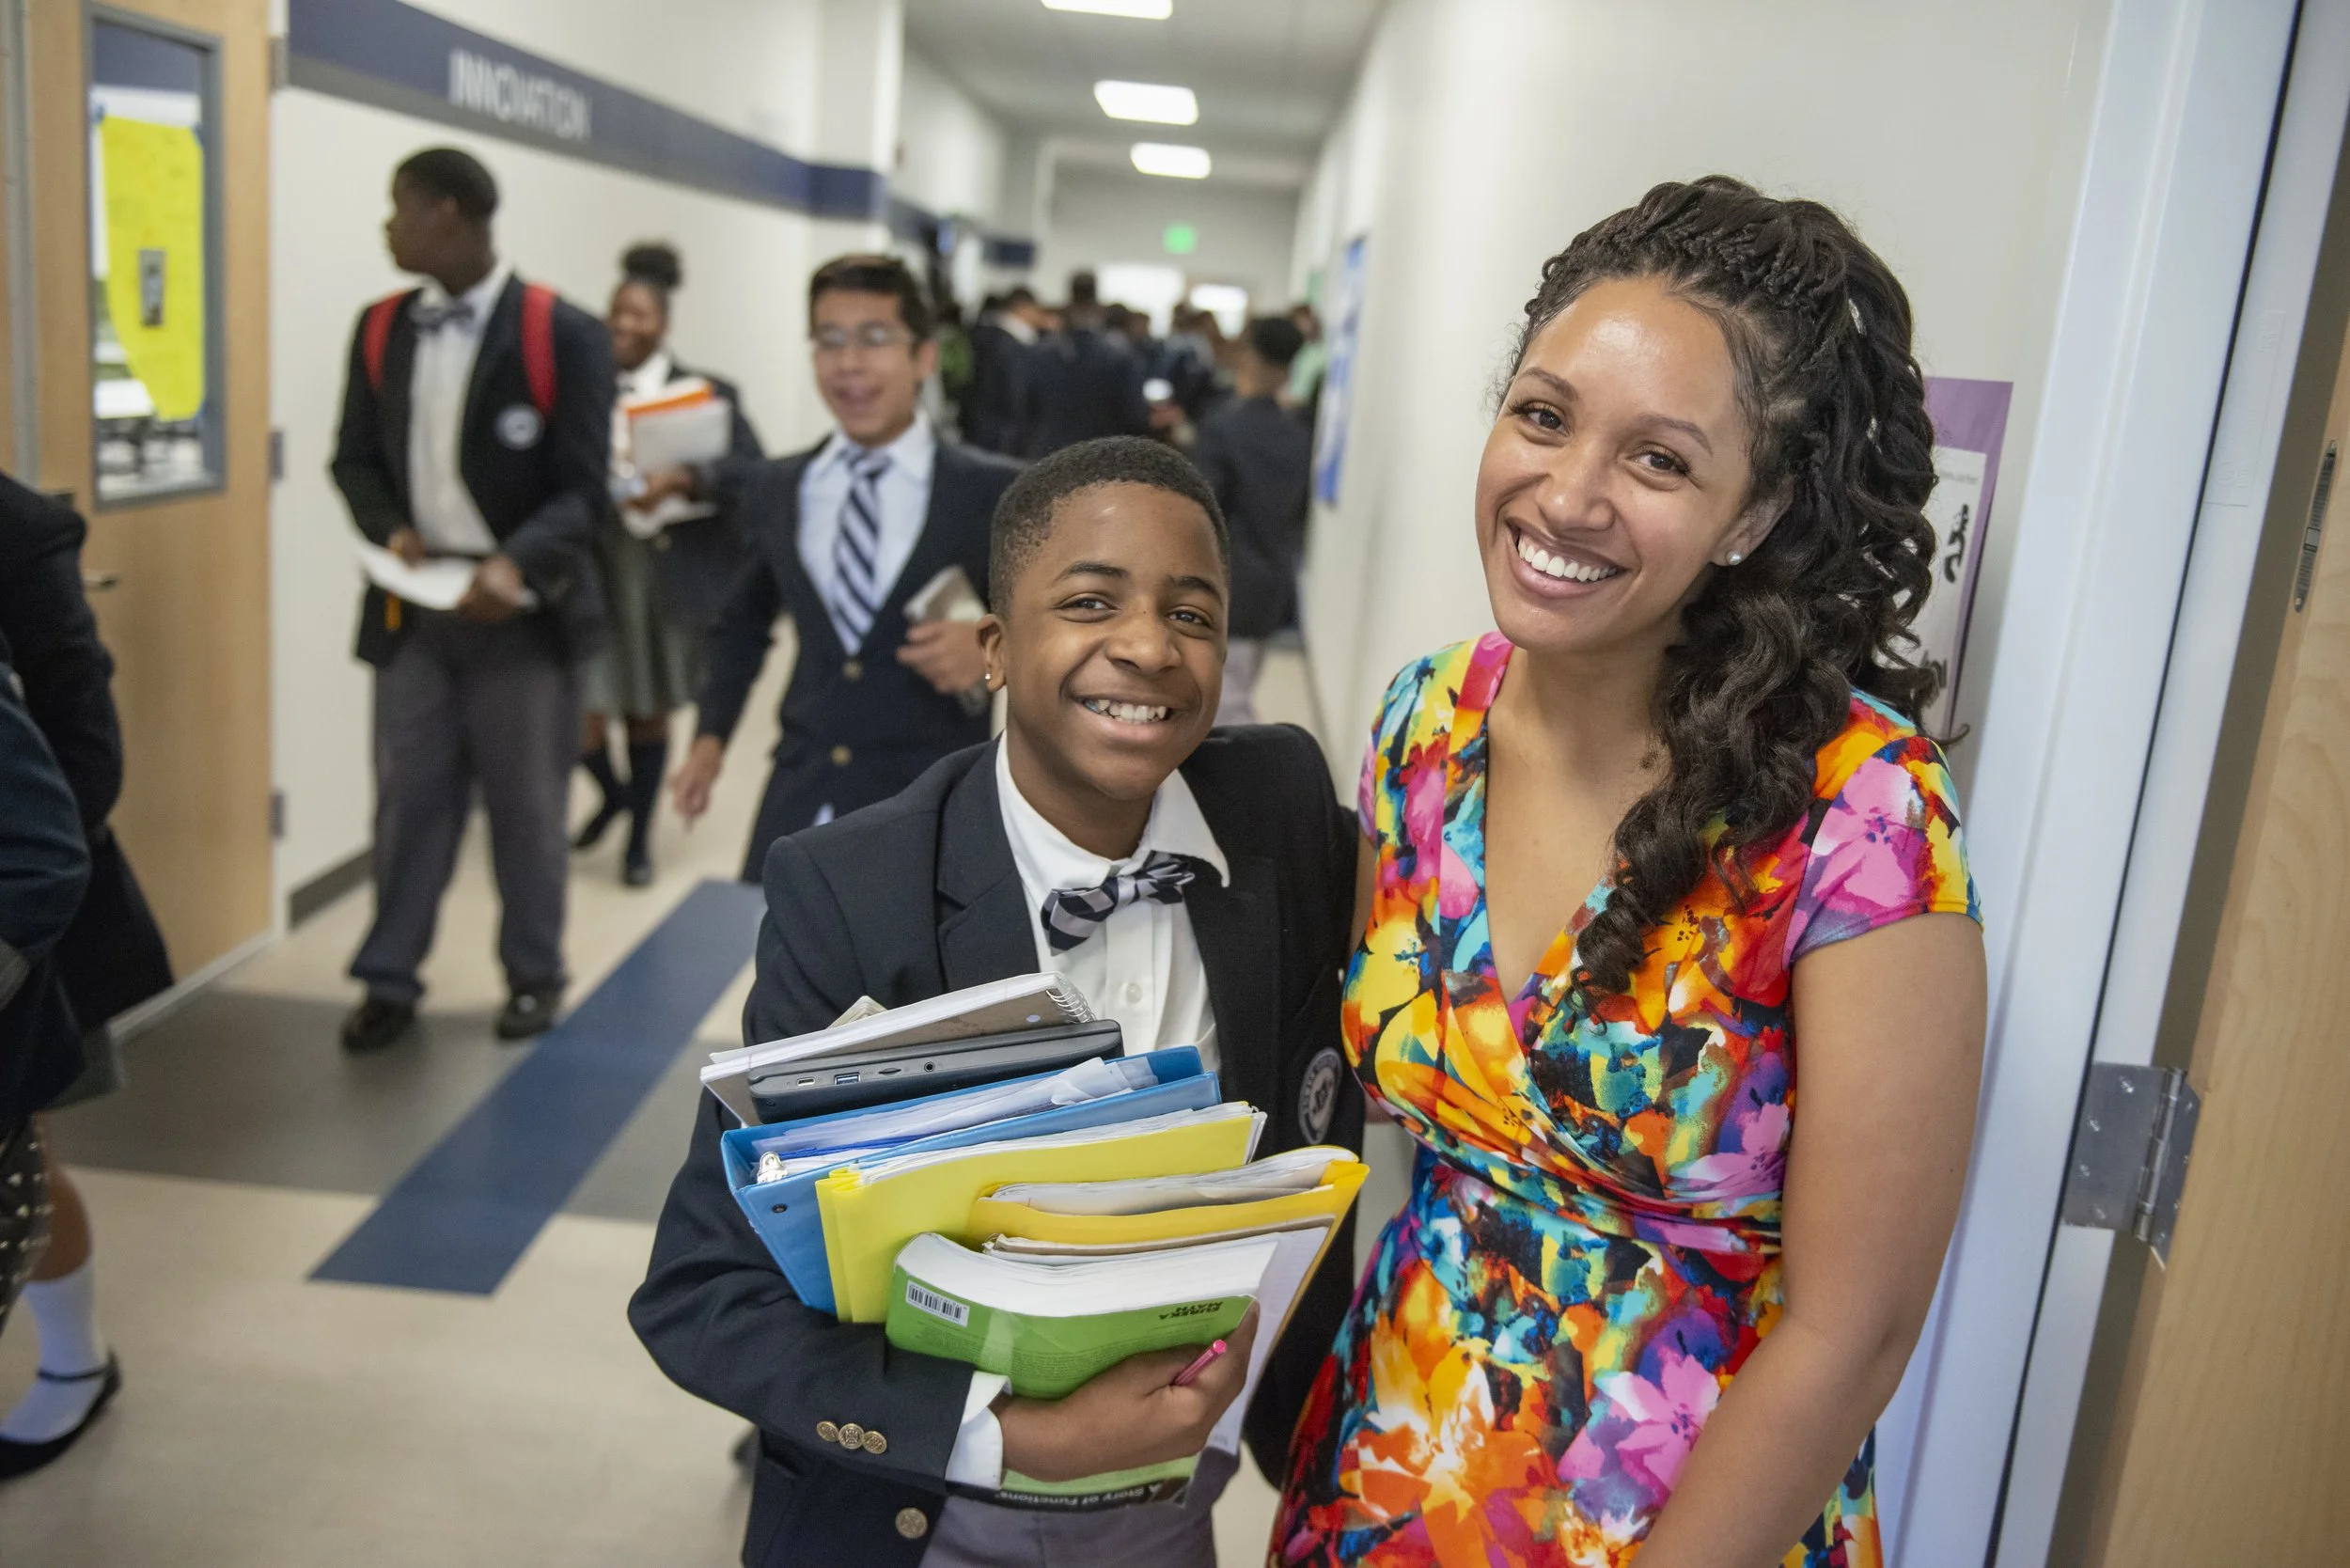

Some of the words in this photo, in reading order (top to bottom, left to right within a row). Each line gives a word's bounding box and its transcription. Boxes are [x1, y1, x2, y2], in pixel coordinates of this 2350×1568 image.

[448, 50, 594, 140] INNOVATION
[1159, 1307, 1220, 1320] EUREKA
[1176, 1302, 1223, 1312] MATH
[1081, 1495, 1100, 1506] of
[1102, 1487, 1144, 1502] Story
